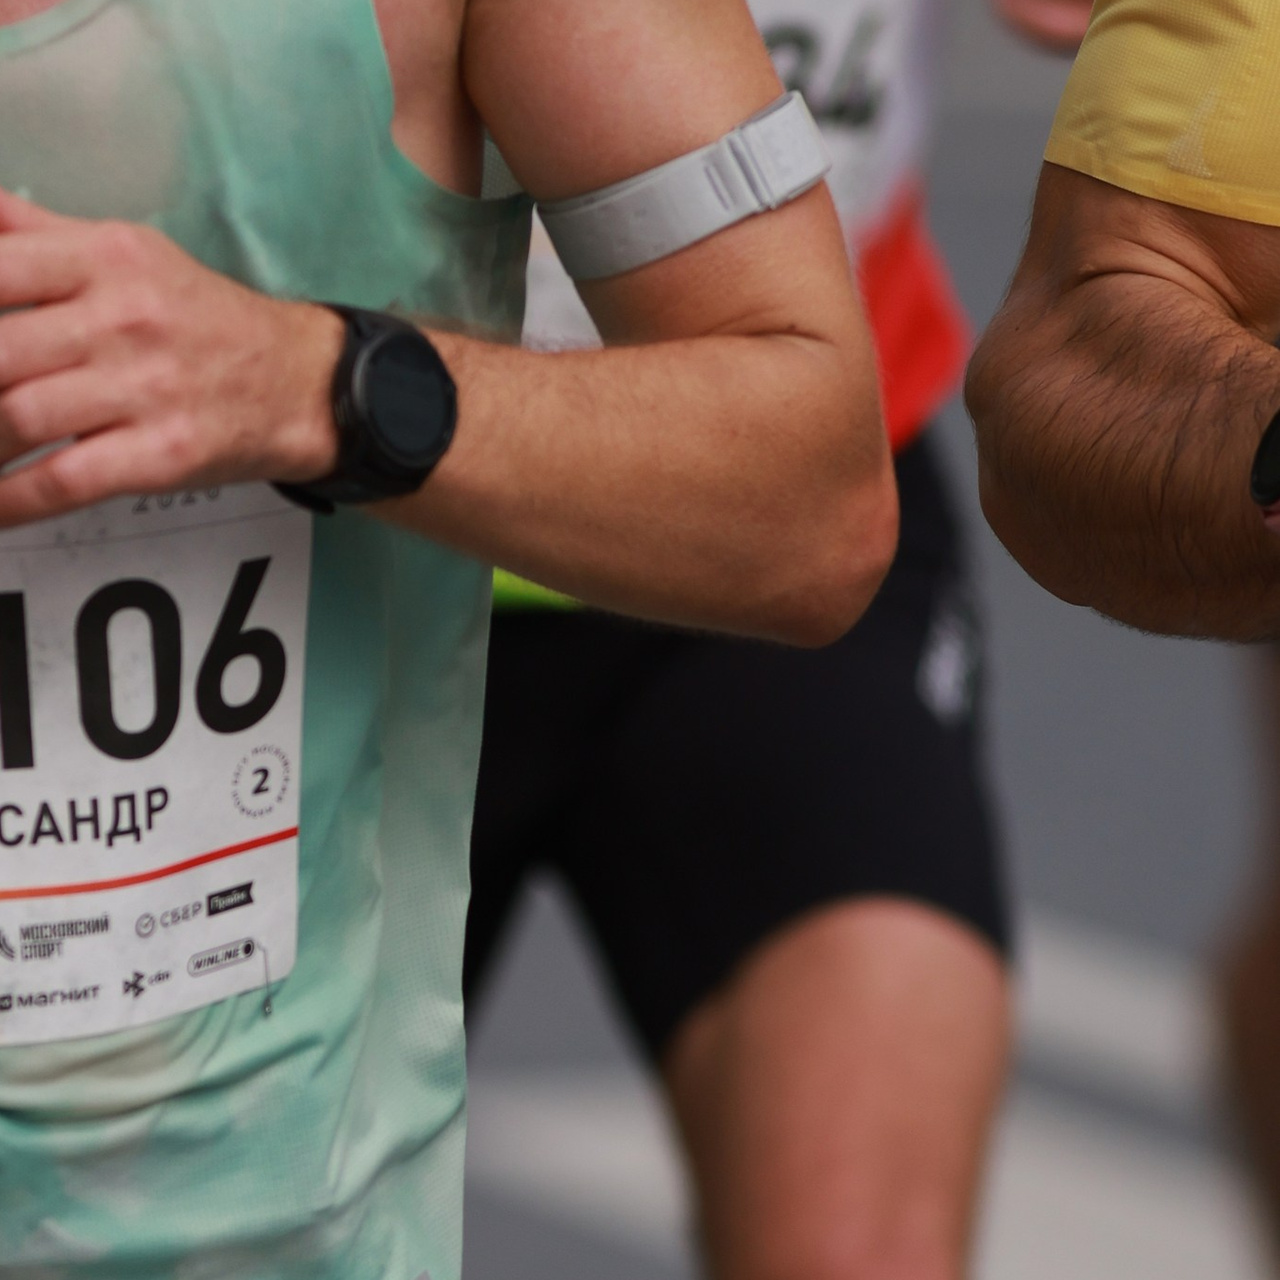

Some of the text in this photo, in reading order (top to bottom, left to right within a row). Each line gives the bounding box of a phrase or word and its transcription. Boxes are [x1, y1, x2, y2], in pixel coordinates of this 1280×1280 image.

[252, 767, 269, 795] 2
[20, 912, 110, 941] МОСКОВСКИЙ
[21, 941, 62, 961] СПОРТ
